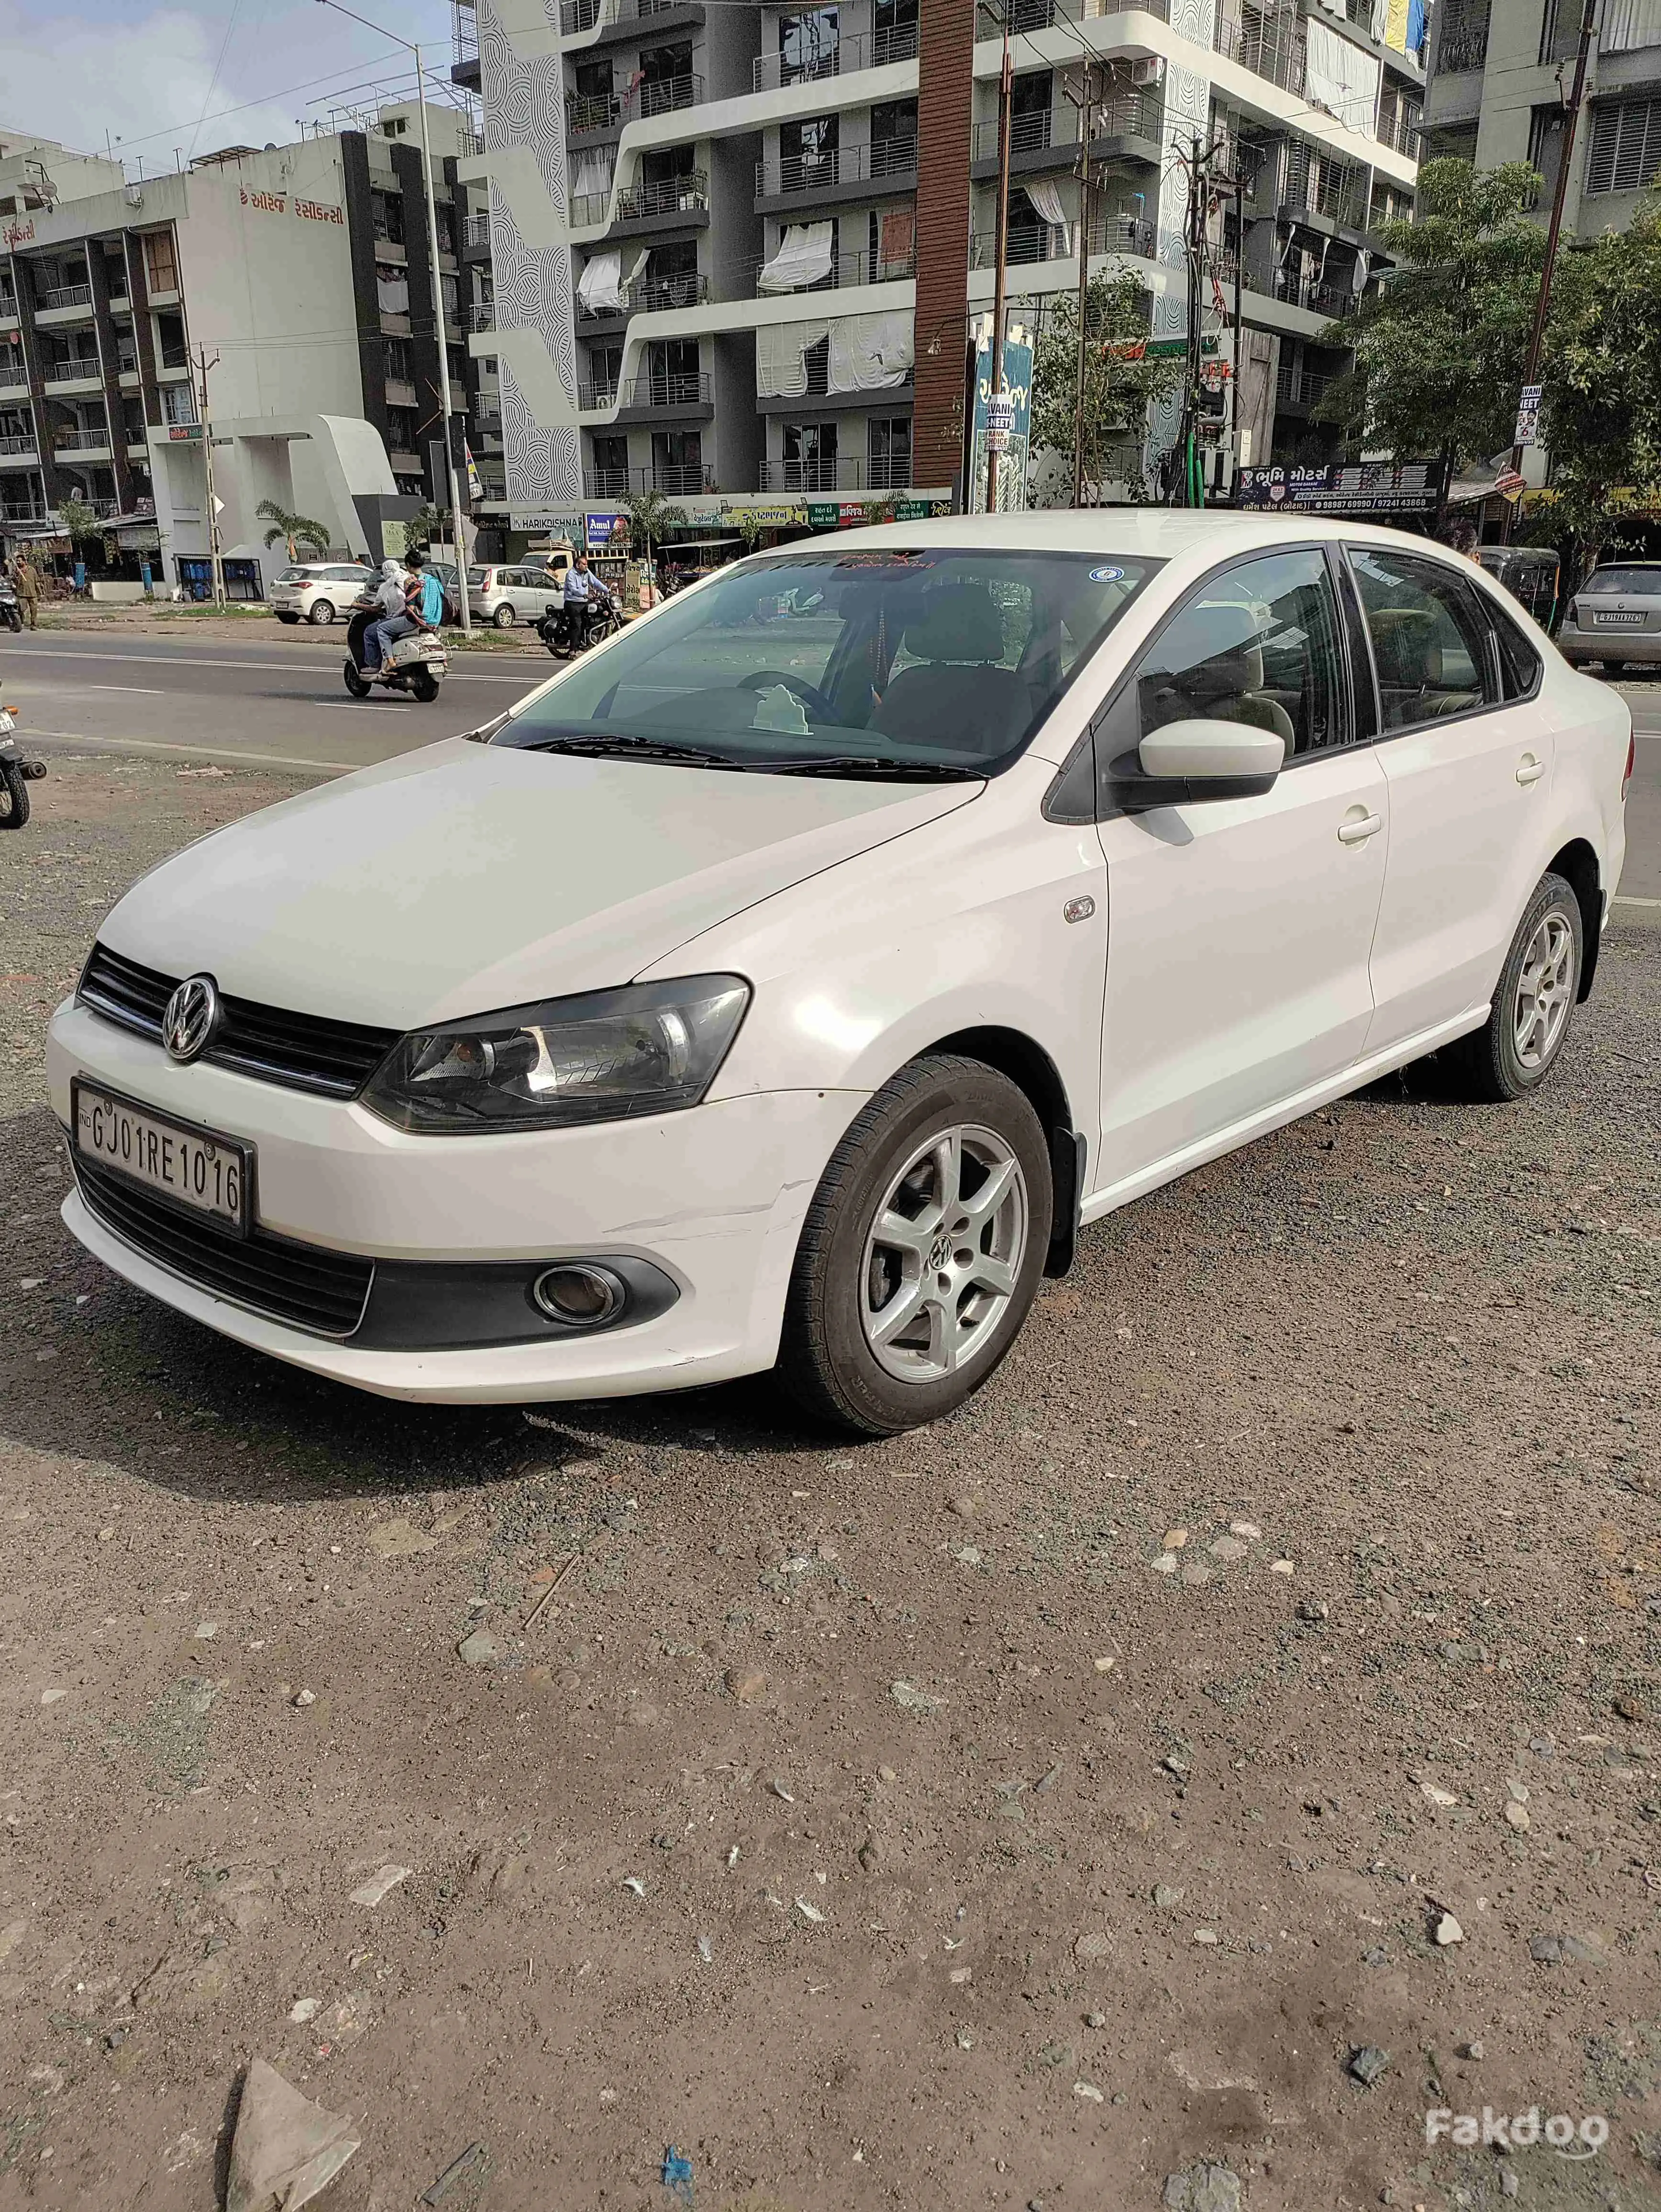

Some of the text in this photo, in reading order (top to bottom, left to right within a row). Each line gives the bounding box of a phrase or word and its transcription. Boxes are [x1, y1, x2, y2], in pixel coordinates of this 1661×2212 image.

[1256, 467, 1285, 487] ભૂમિ
[1290, 465, 1330, 481] મોટર્સ
[1378, 499, 1399, 507] 97241
[1401, 498, 1426, 507] 43868
[589, 519, 610, 530] Amul
[79, 1113, 91, 1128] IND
[93, 1106, 239, 1211] GJ01RE1016
